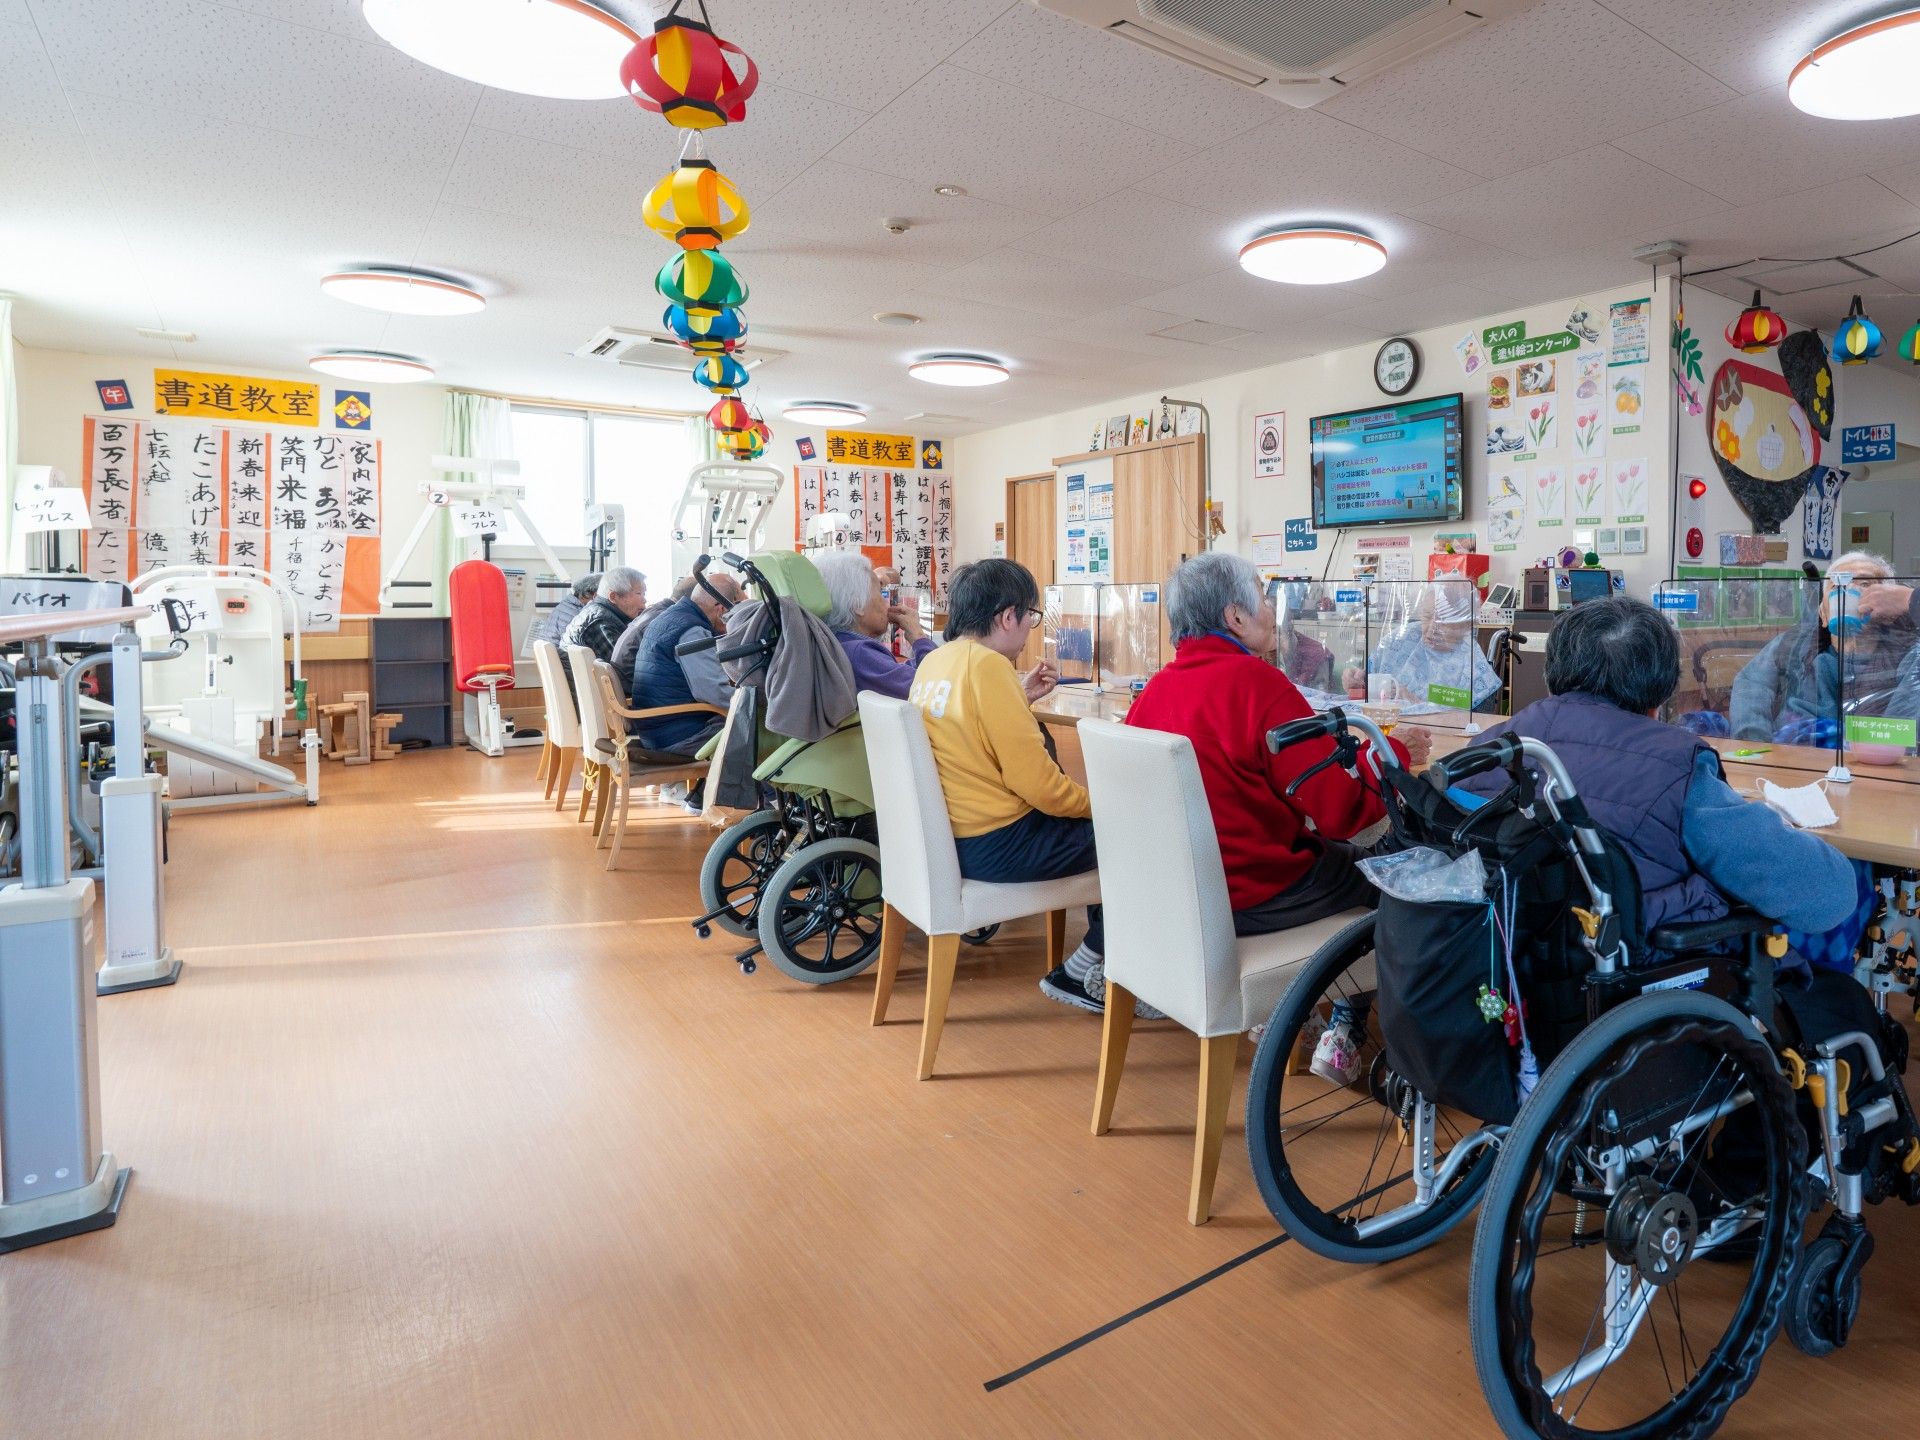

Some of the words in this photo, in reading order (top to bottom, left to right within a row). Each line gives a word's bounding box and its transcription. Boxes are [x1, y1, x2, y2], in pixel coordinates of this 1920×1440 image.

[1488, 327, 1518, 343] 大人の
[1497, 336, 1572, 360] 塗り絵コンクール
[106, 389, 123, 402] 午
[156, 378, 314, 417] 書道教室
[1846, 429, 1871, 442] トイレ
[145, 429, 171, 483] 七転八起
[801, 443, 813, 455] 午
[827, 436, 912, 461] 書道教室
[1852, 443, 1892, 458] こちら
[98, 424, 129, 519] 百万長者
[192, 433, 220, 526] たこあげ
[237, 439, 265, 527] 新春来迎
[277, 436, 307, 530] 笑門来福
[350, 440, 375, 530] 家内安全
[434, 493, 444, 503] 2
[848, 471, 863, 543] 新春の候
[871, 474, 882, 544] おまもり
[893, 472, 911, 543] 鶴寿千歳
[917, 476, 930, 541] はねつき
[460, 511, 495, 520] チェスト
[939, 480, 951, 543] 千福万来
[676, 531, 684, 540] 3
[835, 532, 843, 544] 4
[1286, 523, 1305, 534] トイレ
[1287, 538, 1304, 547] こちら
[314, 539, 344, 622] かどまつ
[11, 592, 71, 608] バイオ
[1868, 721, 1910, 731] デイサービス
